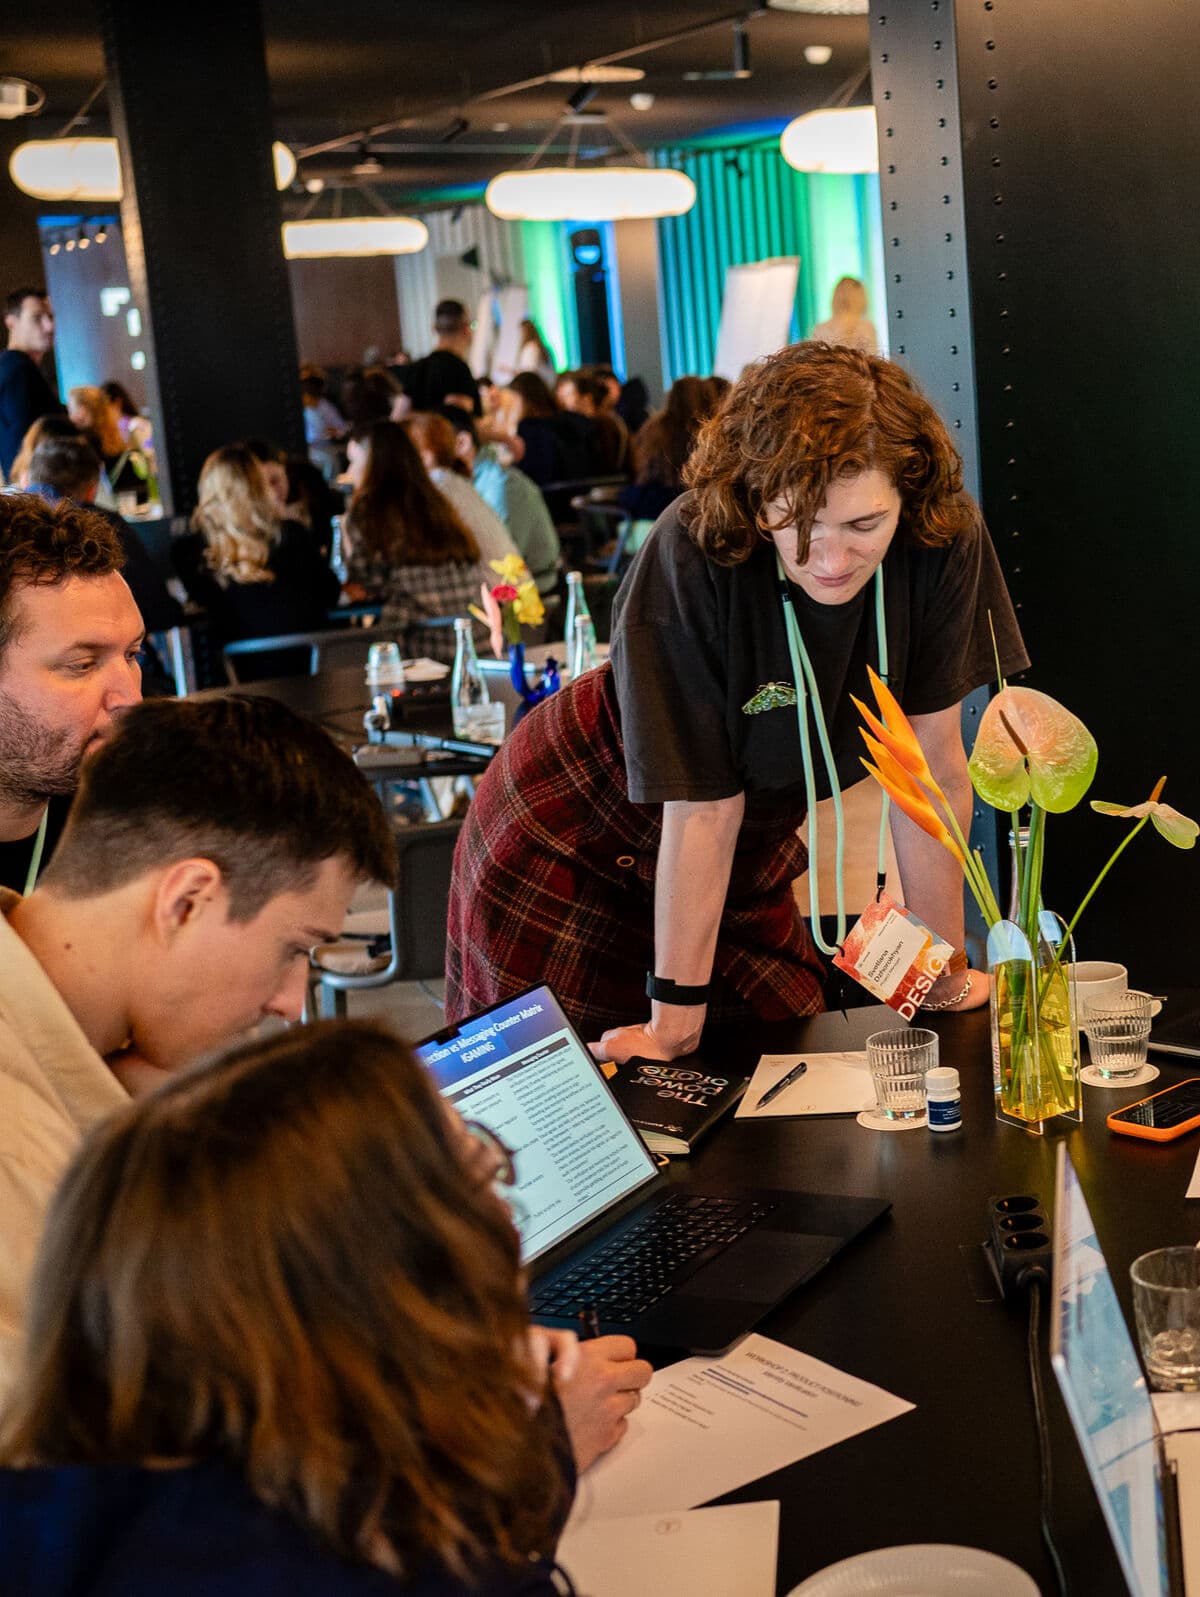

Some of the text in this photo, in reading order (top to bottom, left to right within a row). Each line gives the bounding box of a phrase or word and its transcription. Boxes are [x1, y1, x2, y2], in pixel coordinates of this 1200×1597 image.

[456, 1027, 497, 1049] Messaging
[493, 1014, 521, 1032] Counter
[520, 1004, 544, 1020] Matrix
[656, 1090, 708, 1107] The
